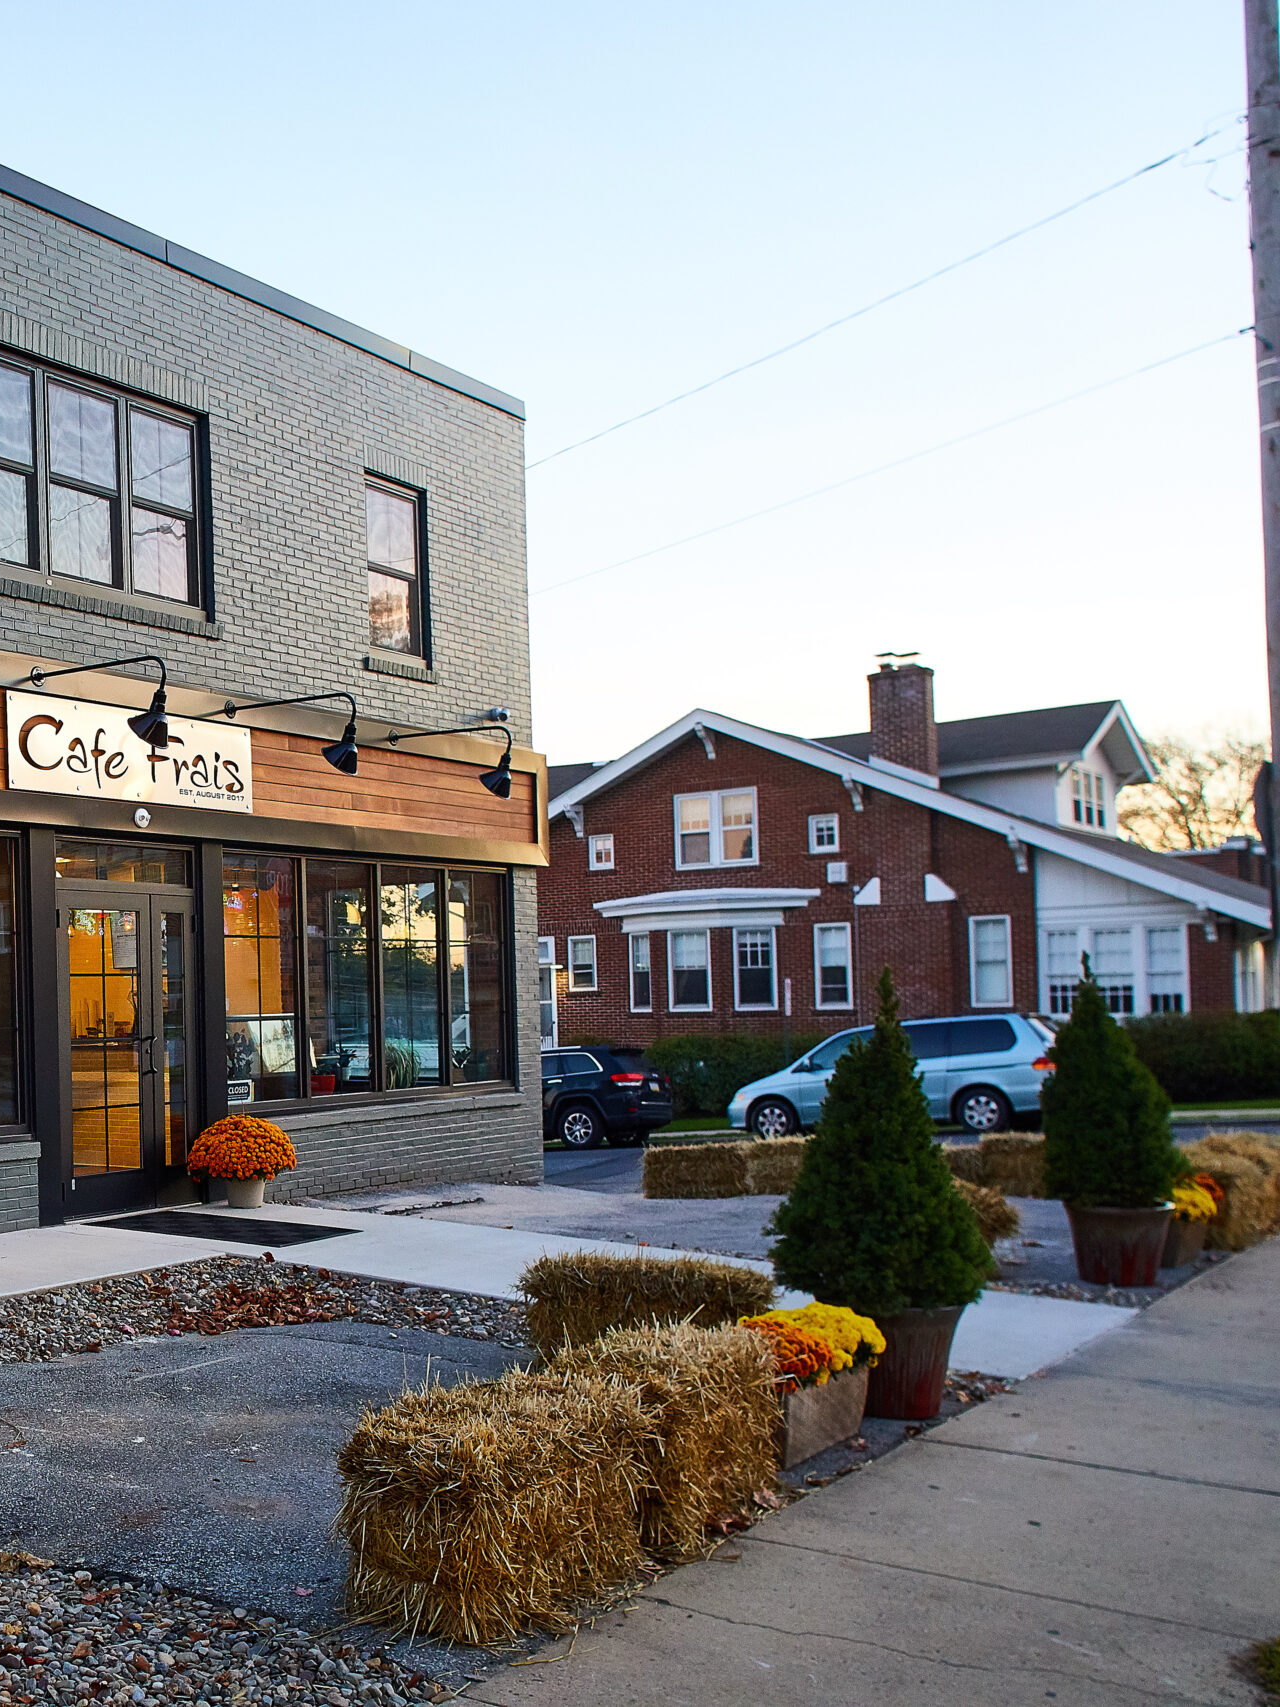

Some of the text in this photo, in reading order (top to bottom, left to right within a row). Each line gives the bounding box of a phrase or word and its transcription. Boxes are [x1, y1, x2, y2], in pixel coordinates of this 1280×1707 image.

[18, 714, 245, 794] Cafe Frais
[179, 788, 195, 796] EST.
[196, 790, 225, 799] AUGUST
[228, 1085, 248, 1094] CLOSED
